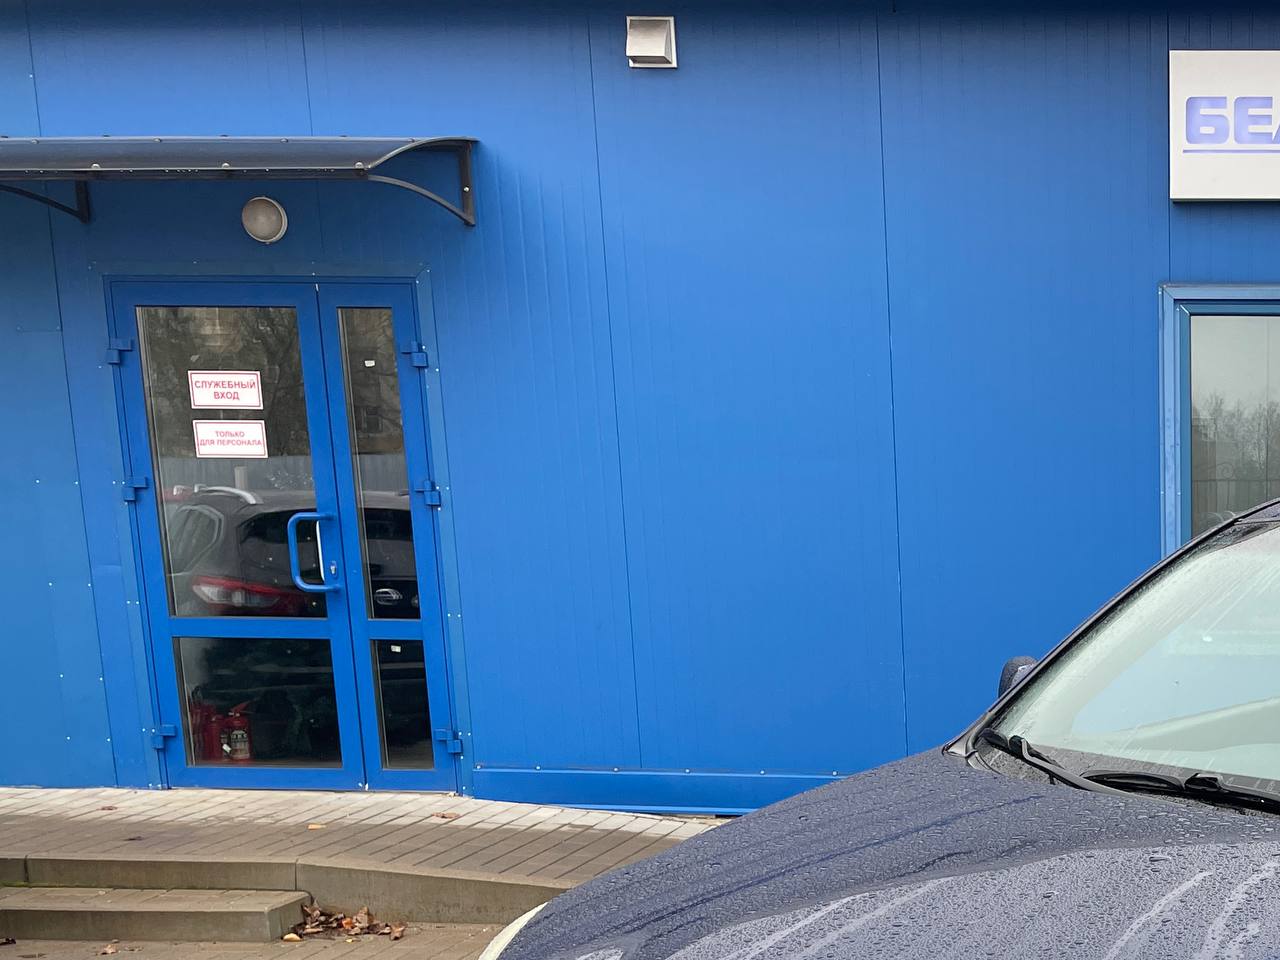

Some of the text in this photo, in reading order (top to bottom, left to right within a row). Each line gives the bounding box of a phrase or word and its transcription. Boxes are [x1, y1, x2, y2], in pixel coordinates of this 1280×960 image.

[194, 379, 256, 389] СЛУЖЕБНЫЙ
[213, 391, 240, 401] ВХОД
[215, 430, 245, 438] ТОЛЬКО
[199, 439, 262, 447] ДЛЯ ПЕРСОНАЛА
